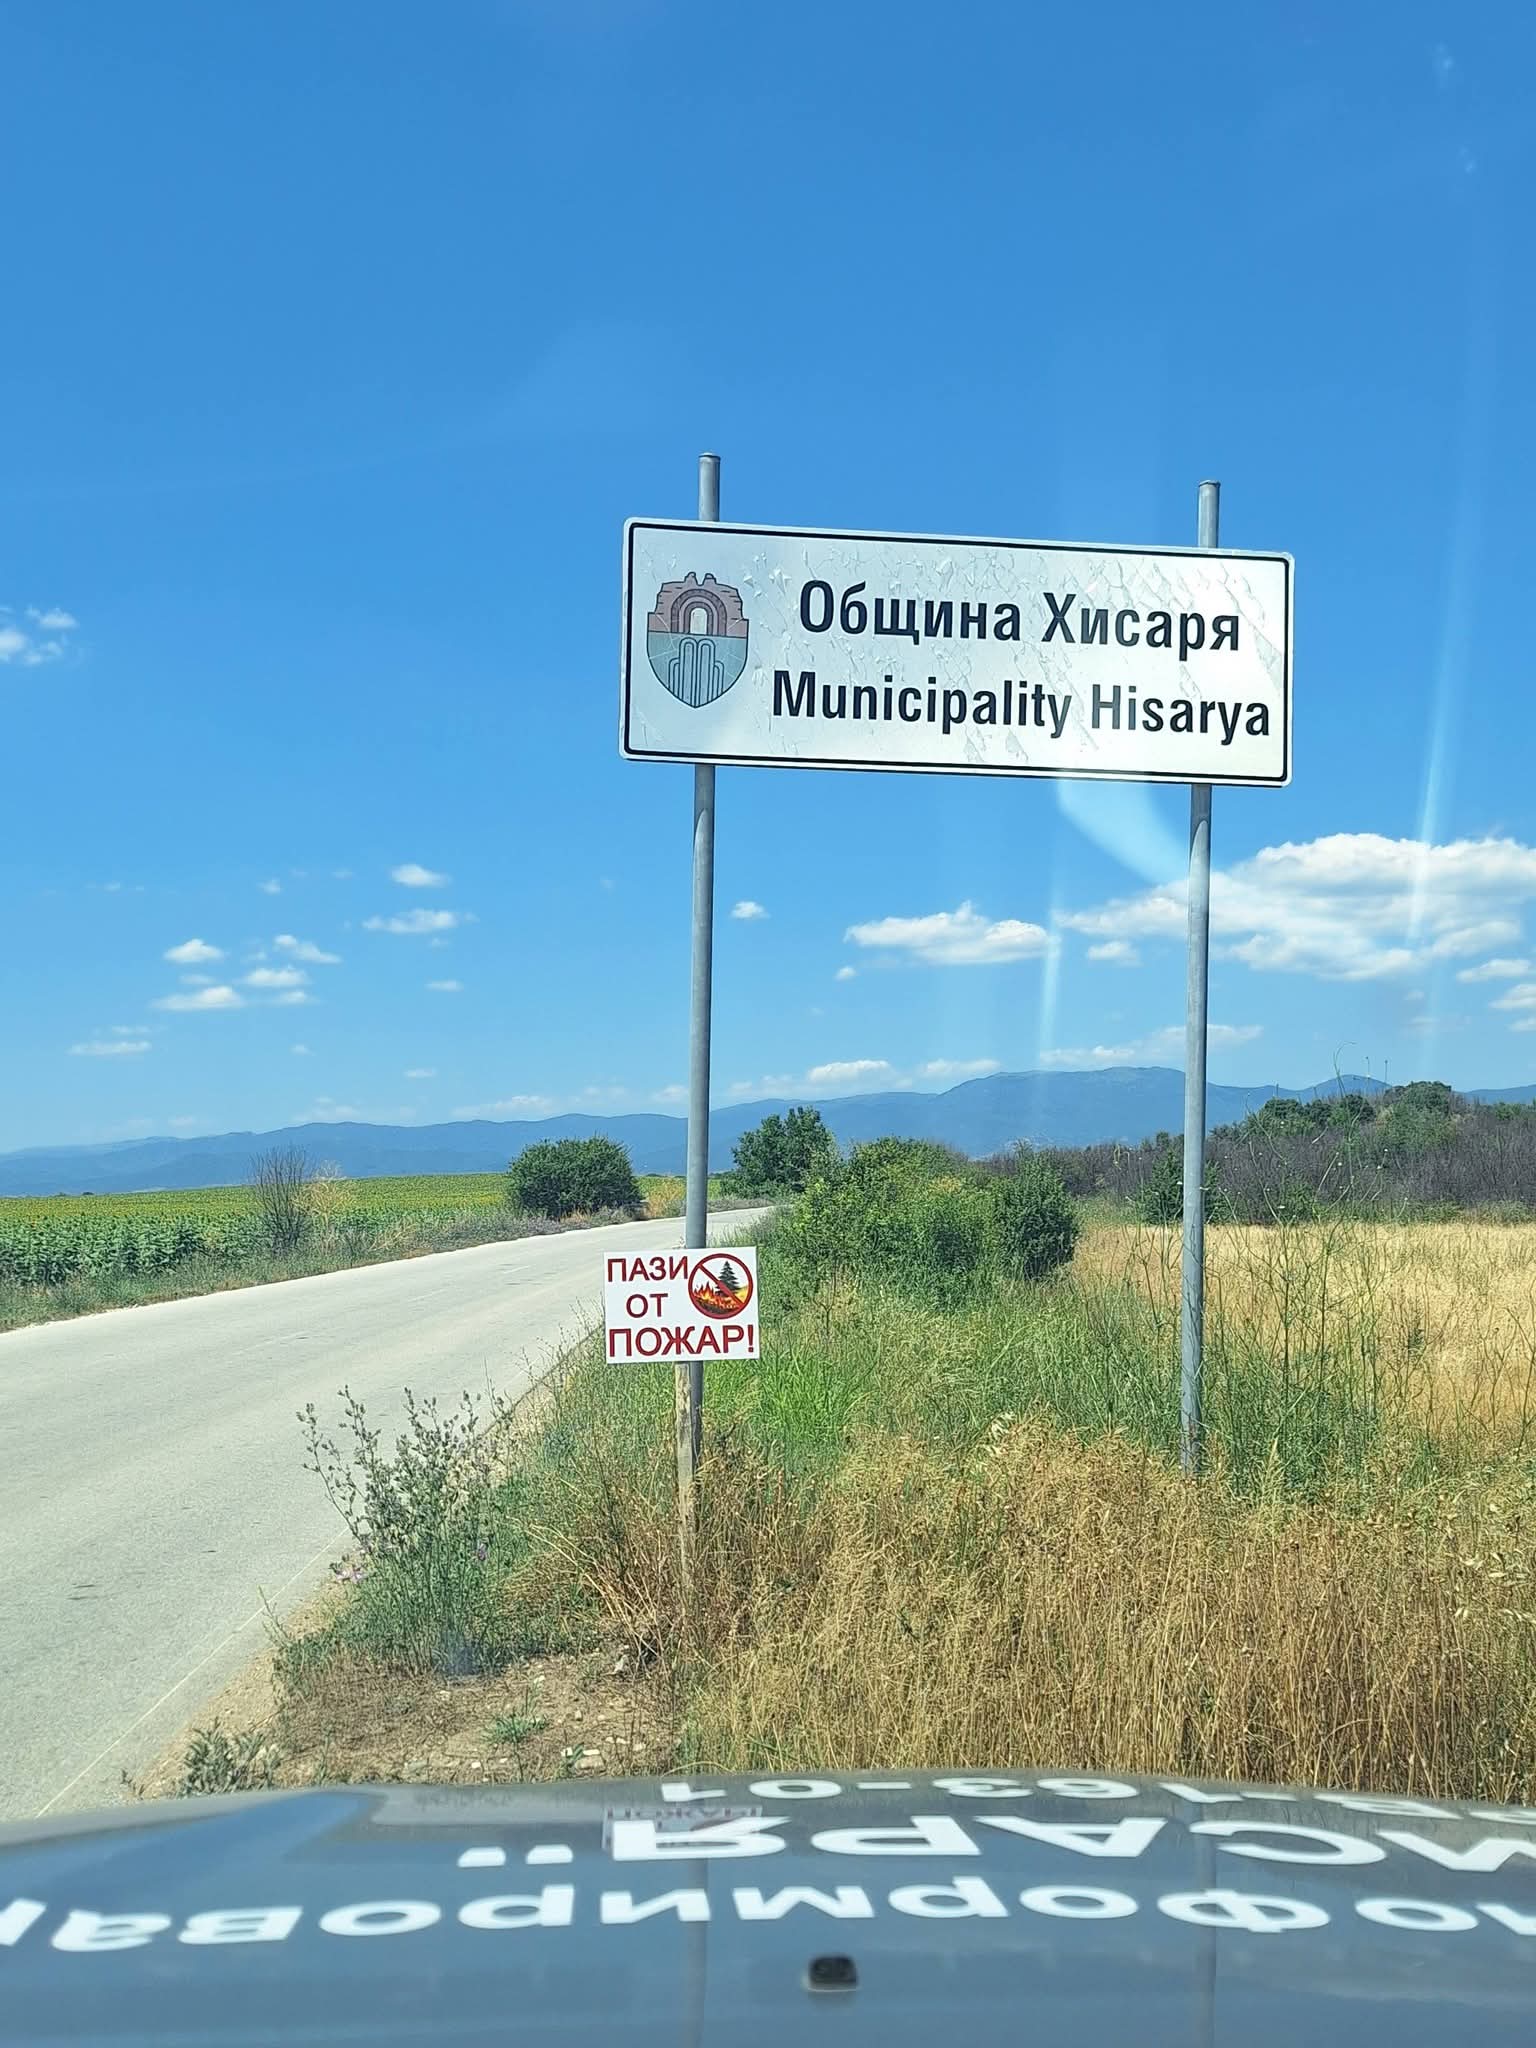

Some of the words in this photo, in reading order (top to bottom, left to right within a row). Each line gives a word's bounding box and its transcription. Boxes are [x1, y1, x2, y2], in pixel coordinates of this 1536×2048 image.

[800, 580, 1021, 646] Община
[1041, 592, 1240, 662] Хисаря
[772, 669, 1072, 739] Municipality
[1091, 684, 1271, 746] Hisarya
[607, 1255, 689, 1283] ПАЗИ
[626, 1292, 669, 1319] ОТ
[609, 1324, 756, 1358] ПОЖАР!
